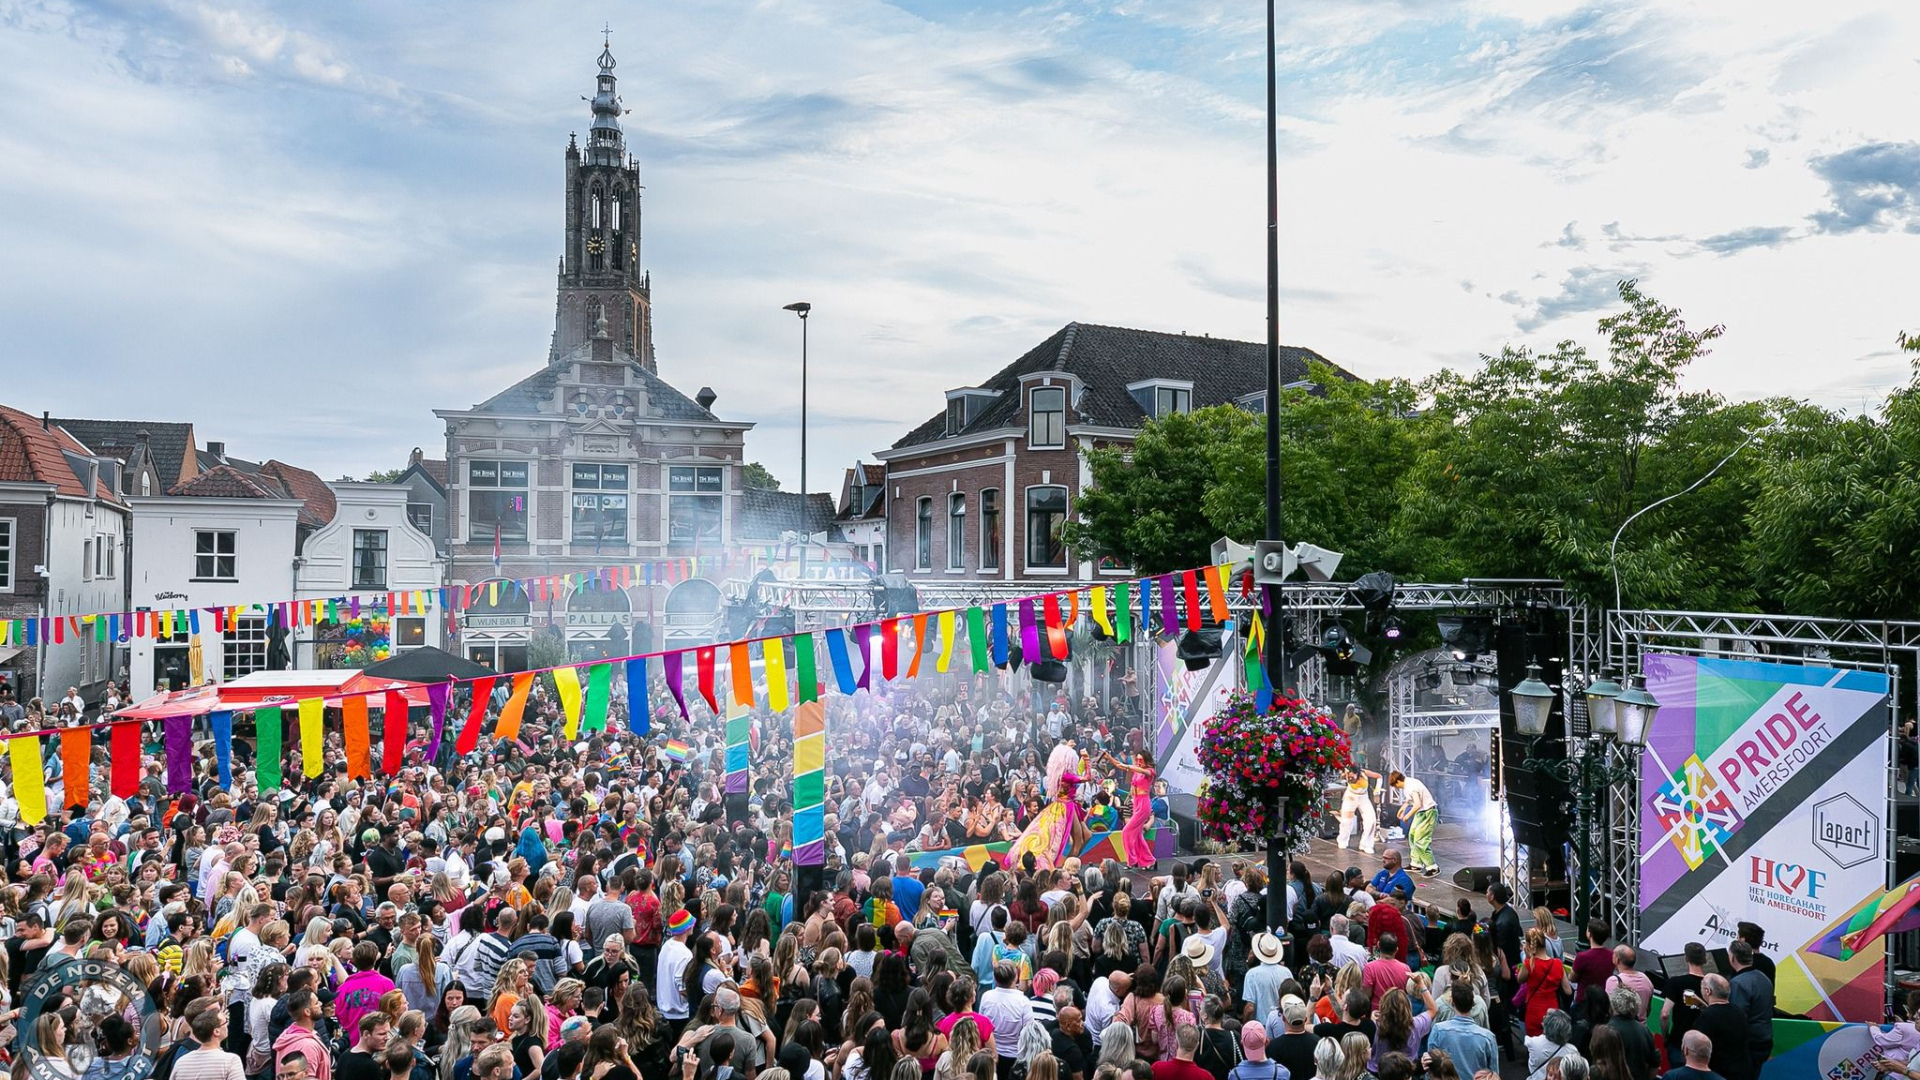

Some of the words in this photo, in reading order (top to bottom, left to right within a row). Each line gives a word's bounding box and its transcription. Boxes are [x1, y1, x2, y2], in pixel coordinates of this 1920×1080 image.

[577, 495, 595, 507] OPEN
[477, 617, 498, 626] WIJN
[500, 617, 516, 626] BAR
[569, 614, 629, 624] PALLAS
[1718, 691, 1821, 794] PRIDE
[1742, 722, 1832, 811] AMERSFOORT
[1749, 885, 1765, 896] HET
[1767, 890, 1827, 913] HORECAHART
[1749, 893, 1765, 905] VAN
[1767, 899, 1827, 921] AMERSFOORT
[1857, 1044, 1883, 1069] PRID
